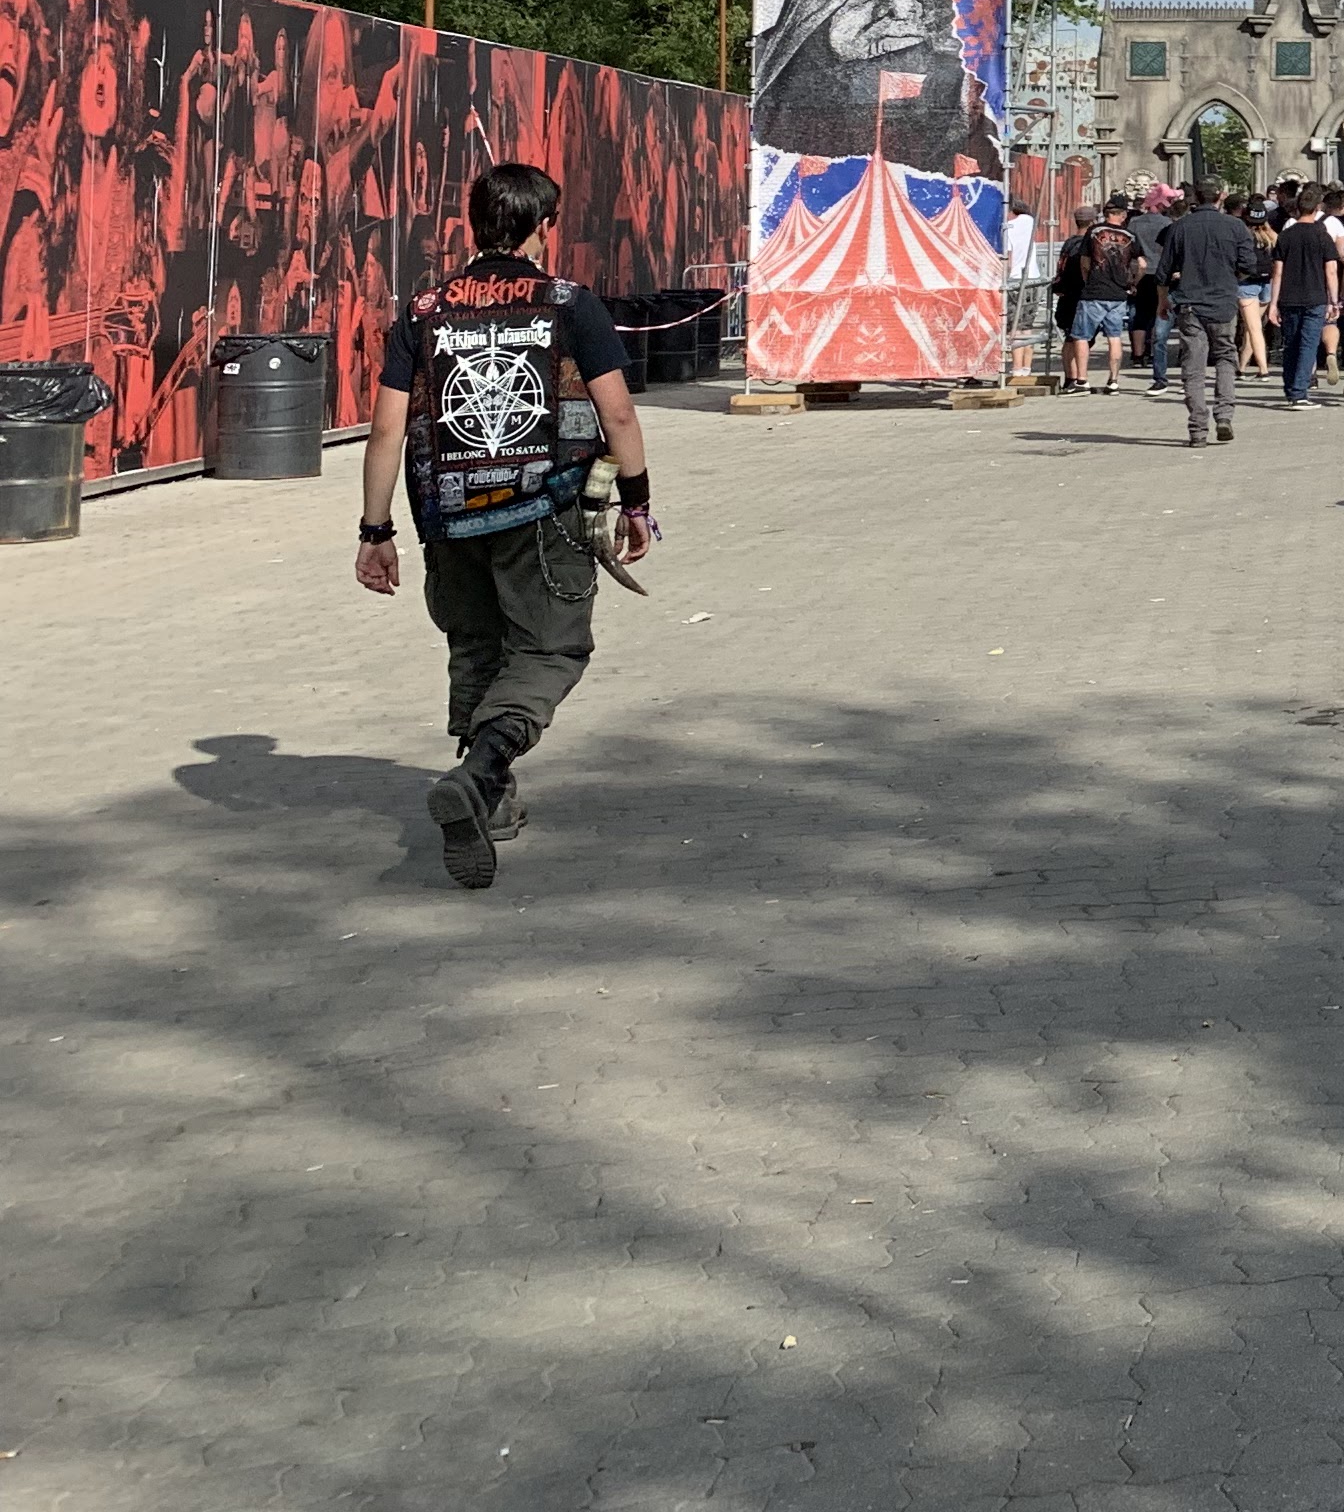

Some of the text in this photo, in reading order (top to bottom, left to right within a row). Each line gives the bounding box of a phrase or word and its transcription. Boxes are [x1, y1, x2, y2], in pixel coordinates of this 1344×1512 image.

[440, 444, 549, 462] I BELONG TO SATAN
